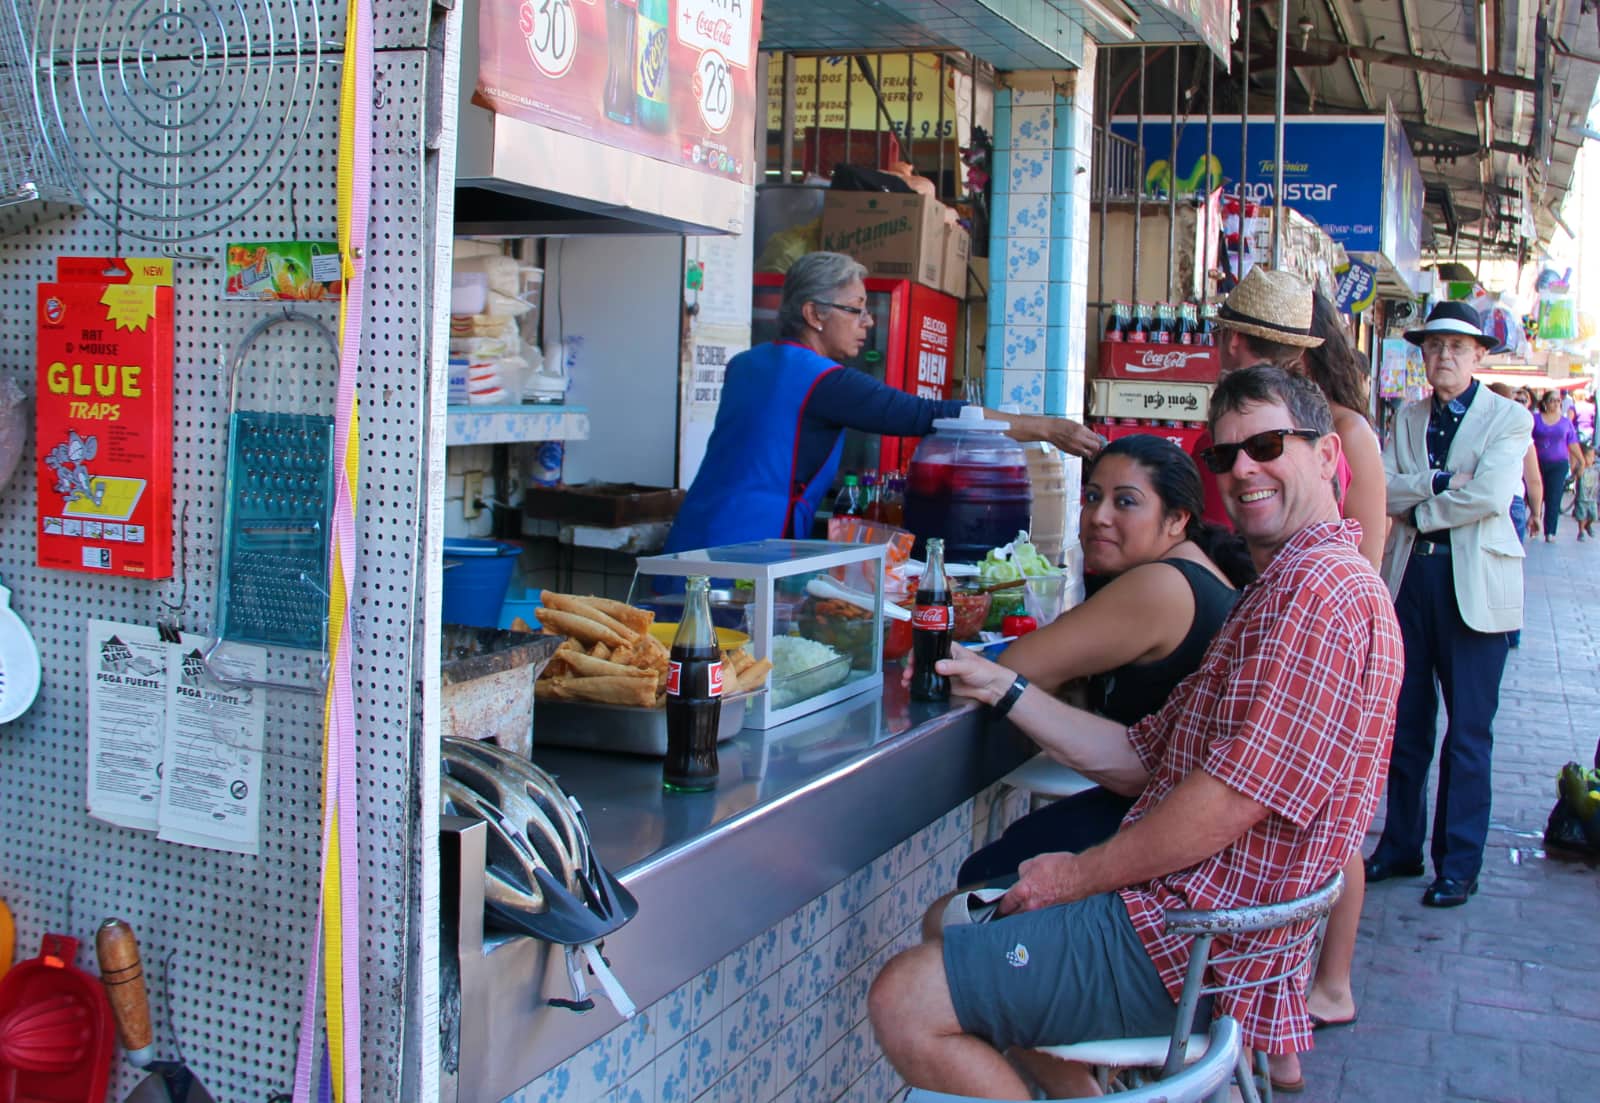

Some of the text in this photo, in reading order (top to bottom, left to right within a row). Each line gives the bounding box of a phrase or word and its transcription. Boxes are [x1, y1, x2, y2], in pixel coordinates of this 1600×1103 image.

[144, 265, 164, 277] NEW
[81, 329, 104, 341] RAT
[79, 343, 120, 356] MOUSE
[918, 351, 947, 385] BIEN
[47, 361, 142, 399] GLUE
[69, 401, 120, 421] TRAPS
[96, 672, 160, 690] PEGA FUERTE
[176, 686, 202, 699] PEGA
